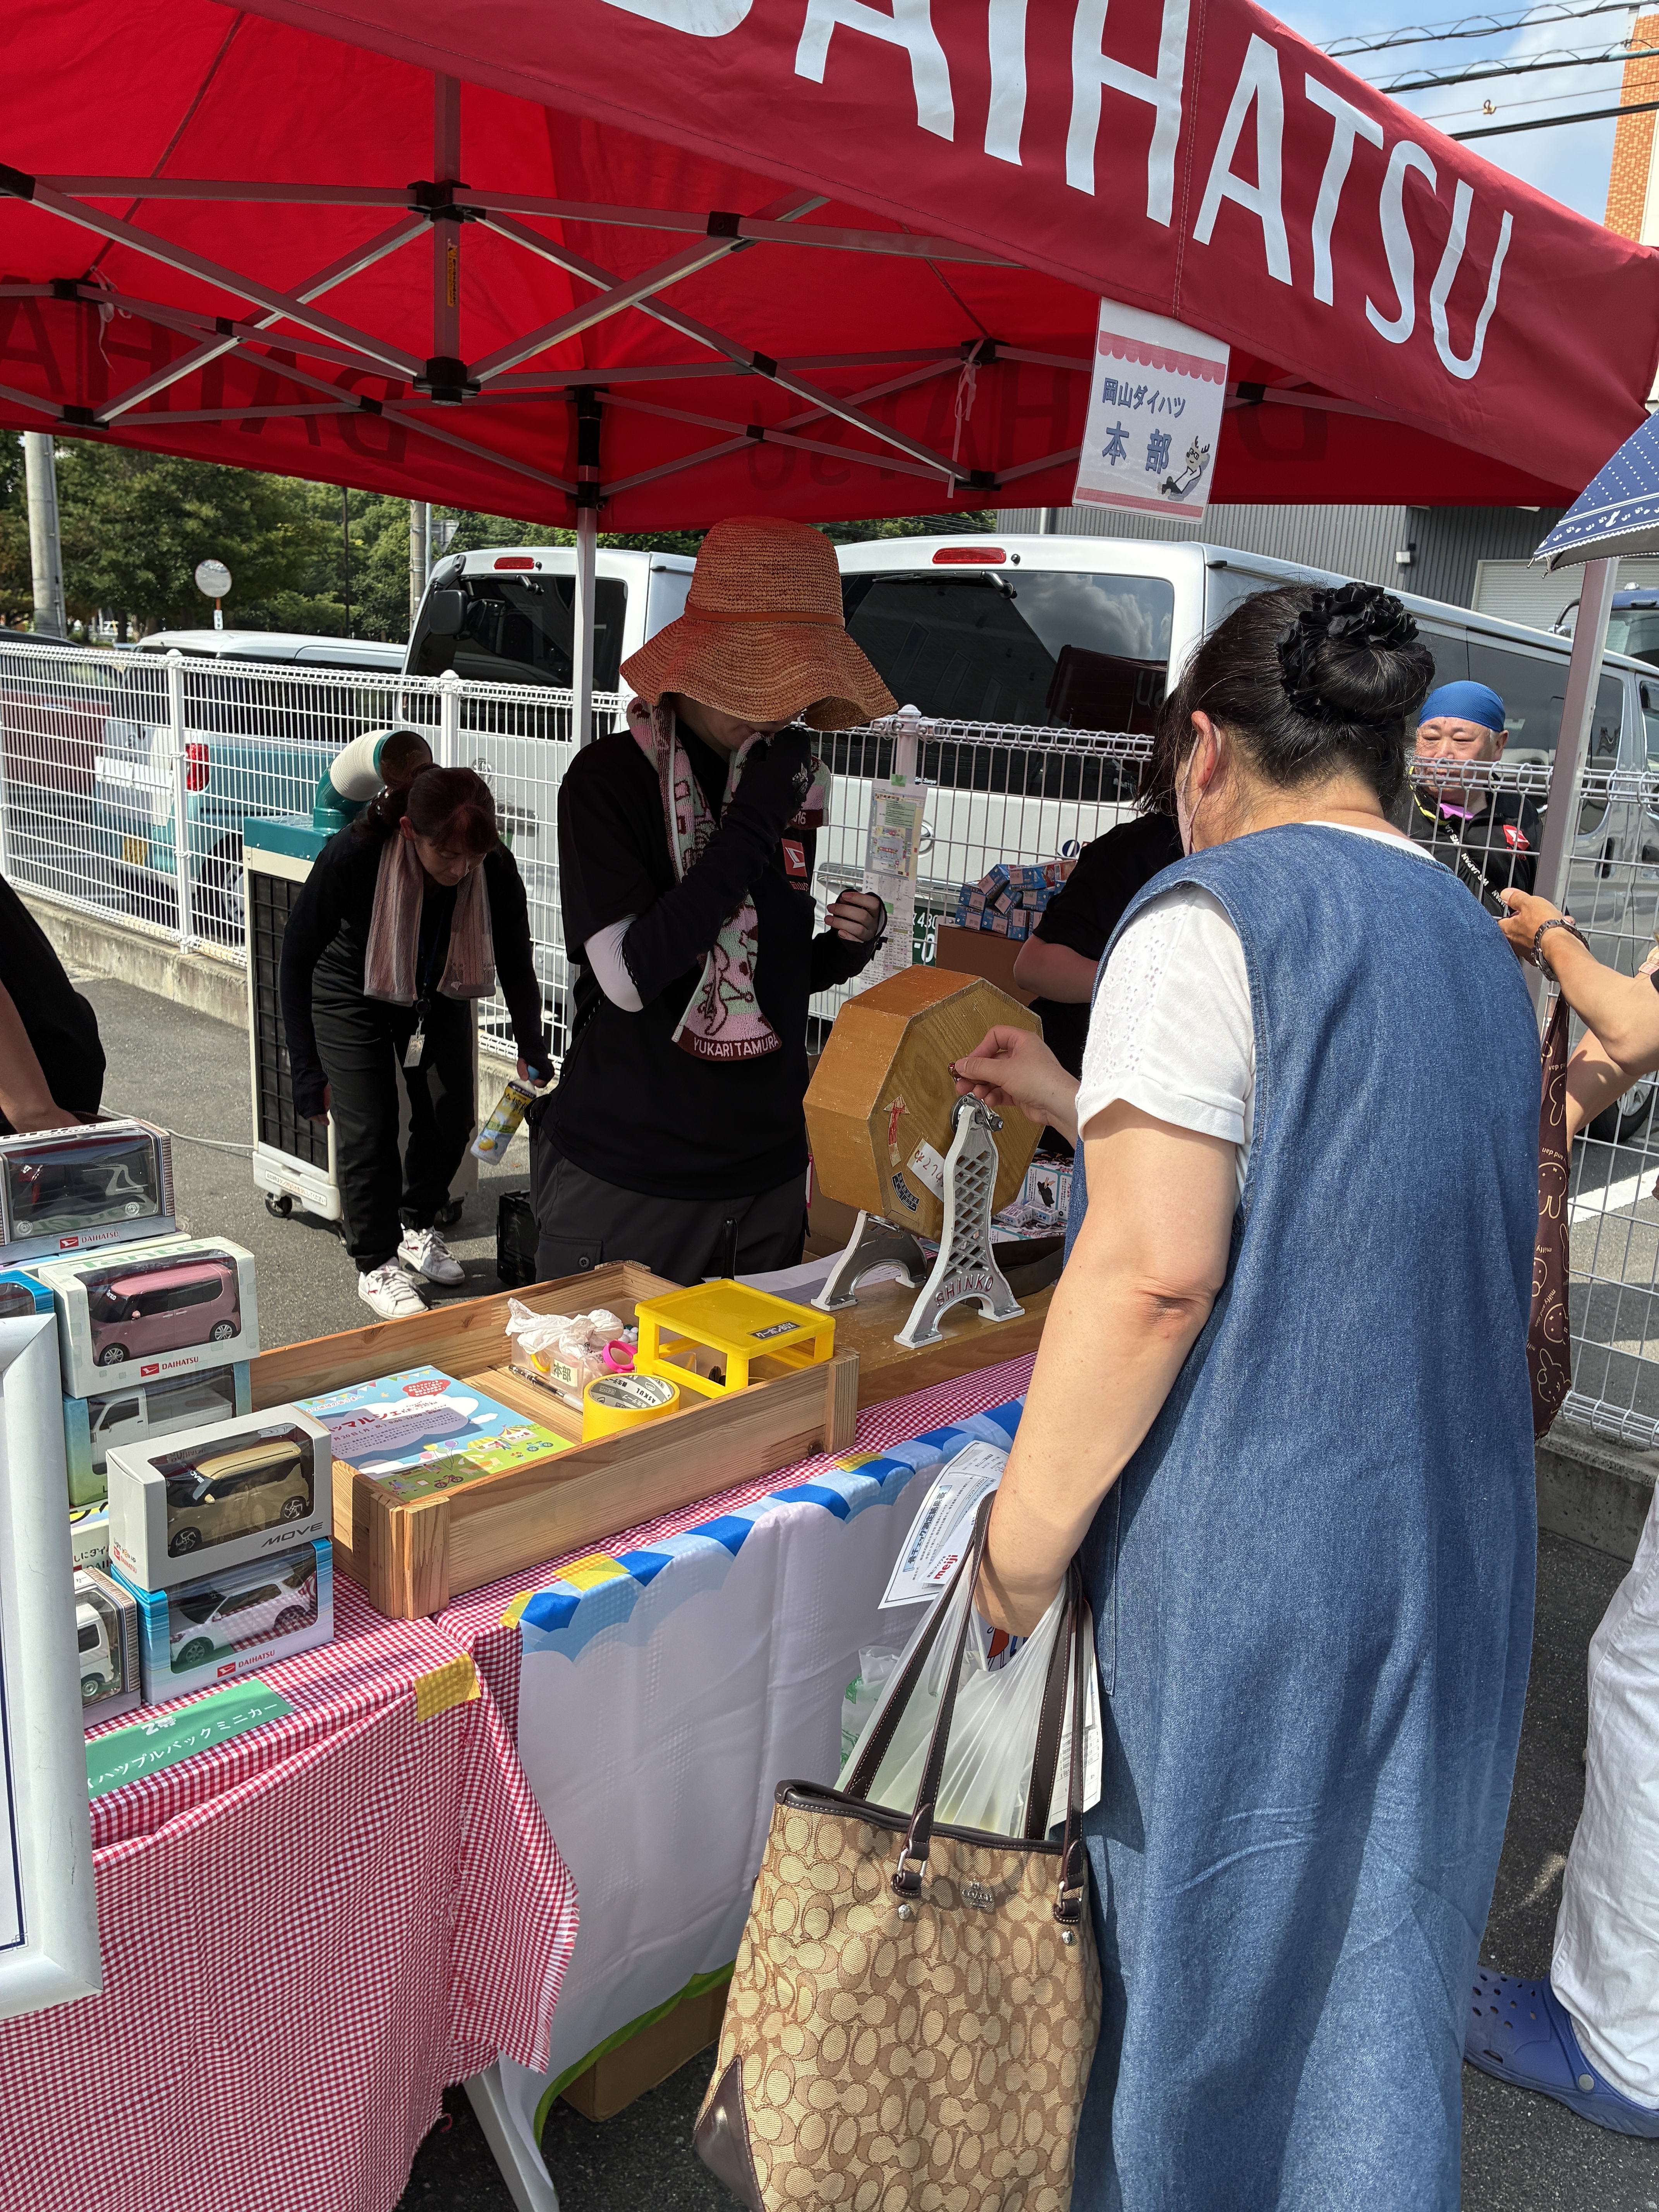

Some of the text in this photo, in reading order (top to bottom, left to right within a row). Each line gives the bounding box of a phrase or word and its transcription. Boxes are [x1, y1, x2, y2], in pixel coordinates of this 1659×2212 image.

[601, 0, 1515, 380] AIHATSU
[1102, 378, 1185, 418] 岡山ダイハツ
[1102, 421, 1172, 474] 本部
[1461, 853, 1480, 874] JAPAN
[694, 1033, 779, 1057] YUKARI TAMURA
[82, 1231, 119, 1243] DAIHATSU
[80, 1244, 204, 1268] Tanto
[1536, 1245, 1552, 1253] miffy
[935, 1274, 994, 1307] SHINKO
[1544, 1289, 1556, 1305] miffy
[756, 1322, 796, 1337] クーポンBOX
[162, 1356, 199, 1370] DAIHATSU
[636, 1388, 656, 1404] ASKUL
[261, 1522, 324, 1549] MOVE
[934, 1554, 958, 1579] meiji
[238, 1649, 275, 1668] DAIHATSU
[141, 1716, 176, 1736] 2等
